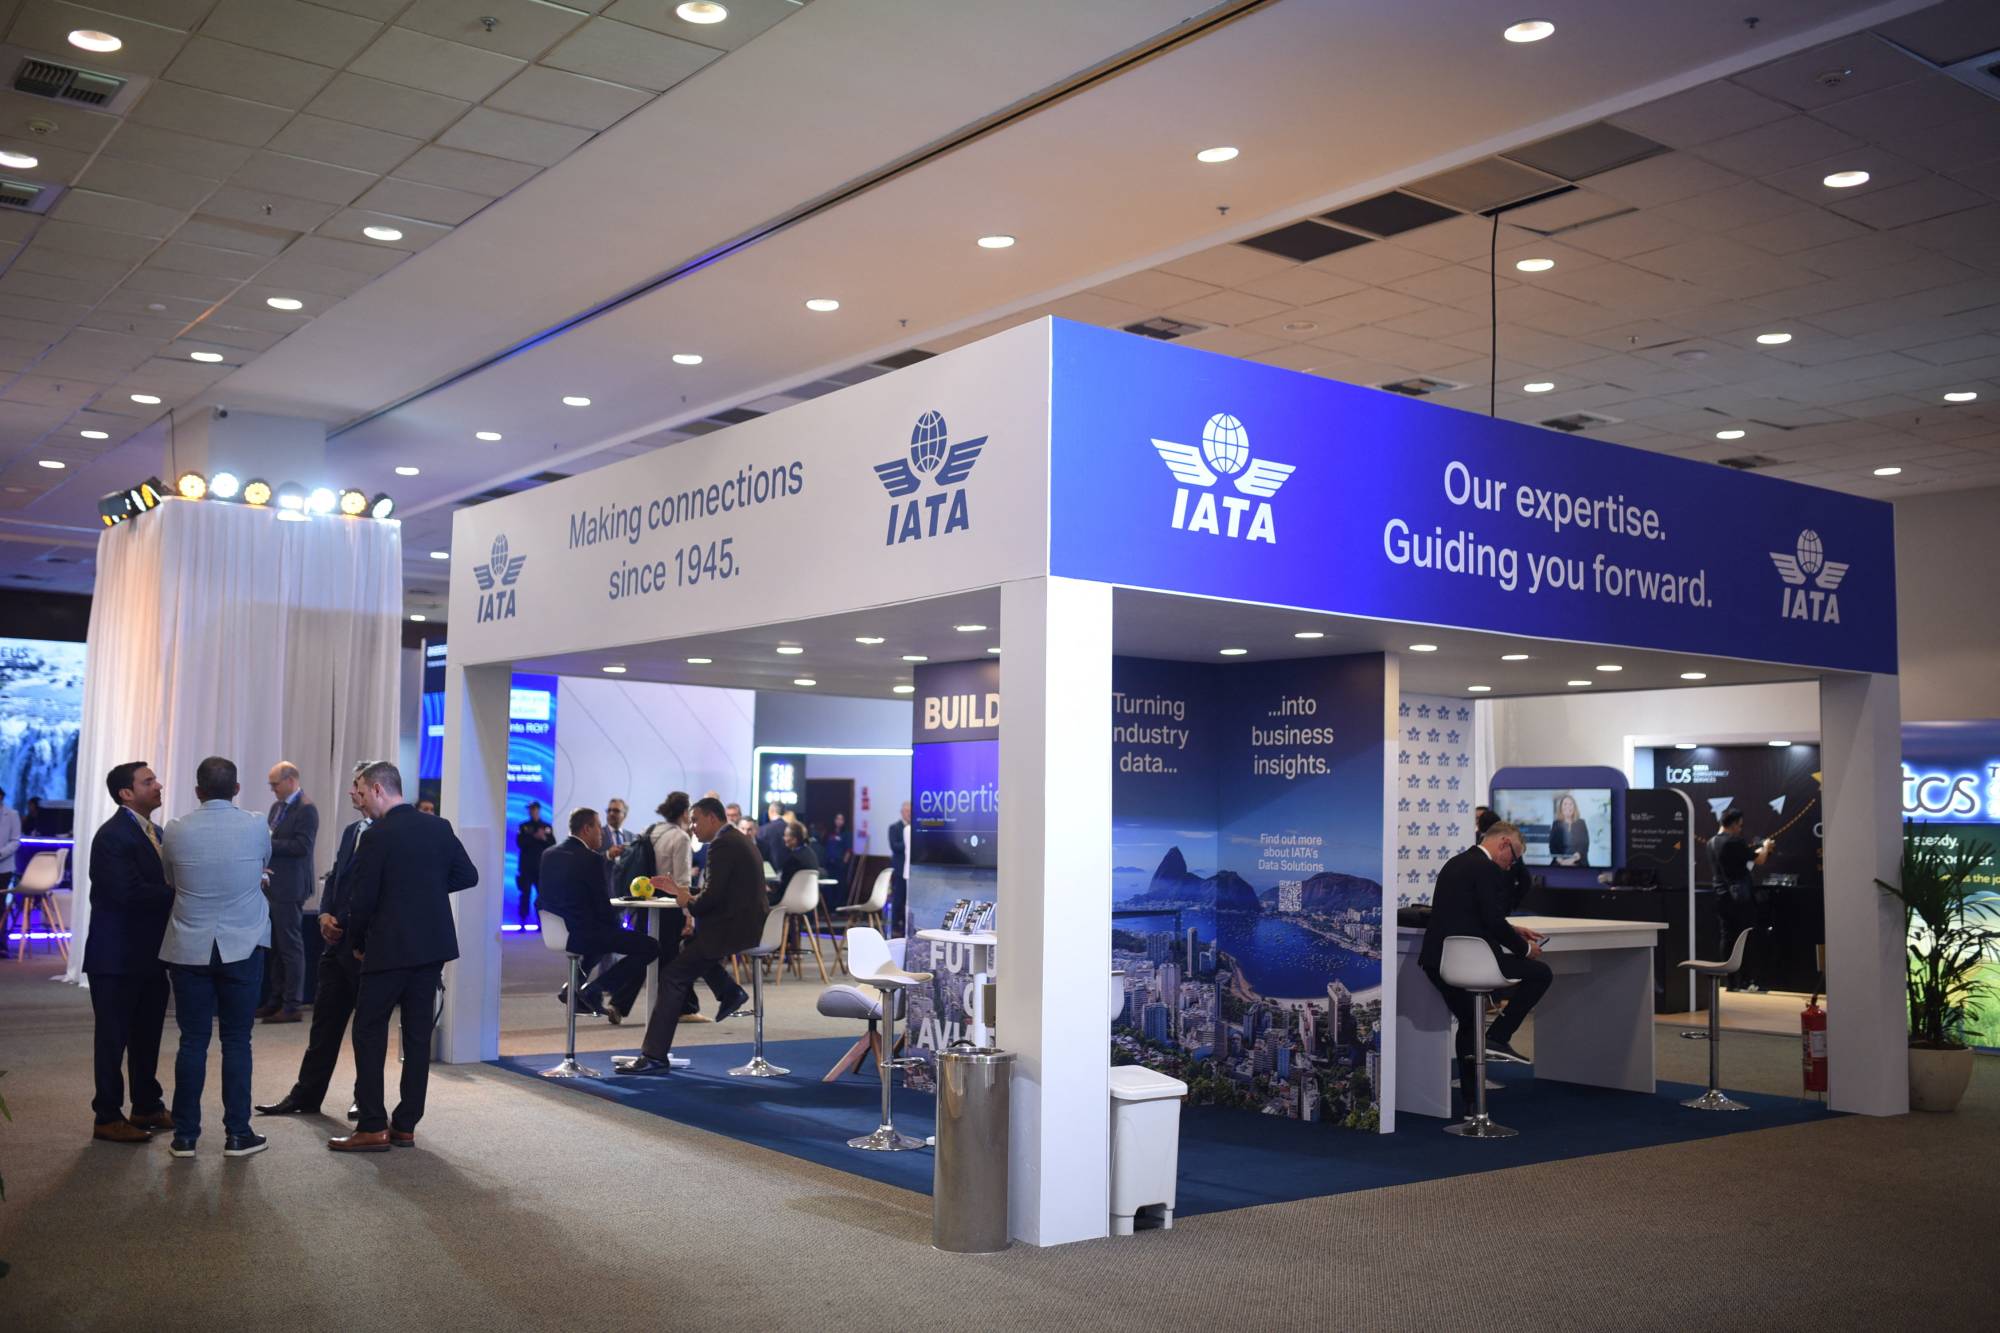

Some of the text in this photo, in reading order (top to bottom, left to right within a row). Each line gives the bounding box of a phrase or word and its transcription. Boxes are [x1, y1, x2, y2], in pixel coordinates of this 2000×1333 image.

[569, 460, 804, 550] Making connections
[1445, 460, 1667, 542] Our expertise.
[885, 488, 970, 546] IATA
[1171, 487, 1277, 545] IATA
[608, 538, 741, 601] since 1945.
[1383, 518, 1713, 608] Guiding you forward.
[476, 589, 517, 624] IATA
[1781, 587, 1842, 624] IATA
[924, 692, 1000, 730] BUILD
[1112, 692, 1185, 721] Turning
[1268, 695, 1317, 717] ...into
[1113, 723, 1189, 750] ndustry
[1252, 725, 1334, 746] business
[1119, 752, 1178, 774] data...
[1254, 753, 1331, 780] insights.
[1666, 765, 1692, 783] tcs
[1260, 831, 1322, 846] Find out more
[1263, 845, 1319, 859] about IATA's
[1258, 859, 1325, 872] Data Solutions
[1972, 873, 1991, 884] the
